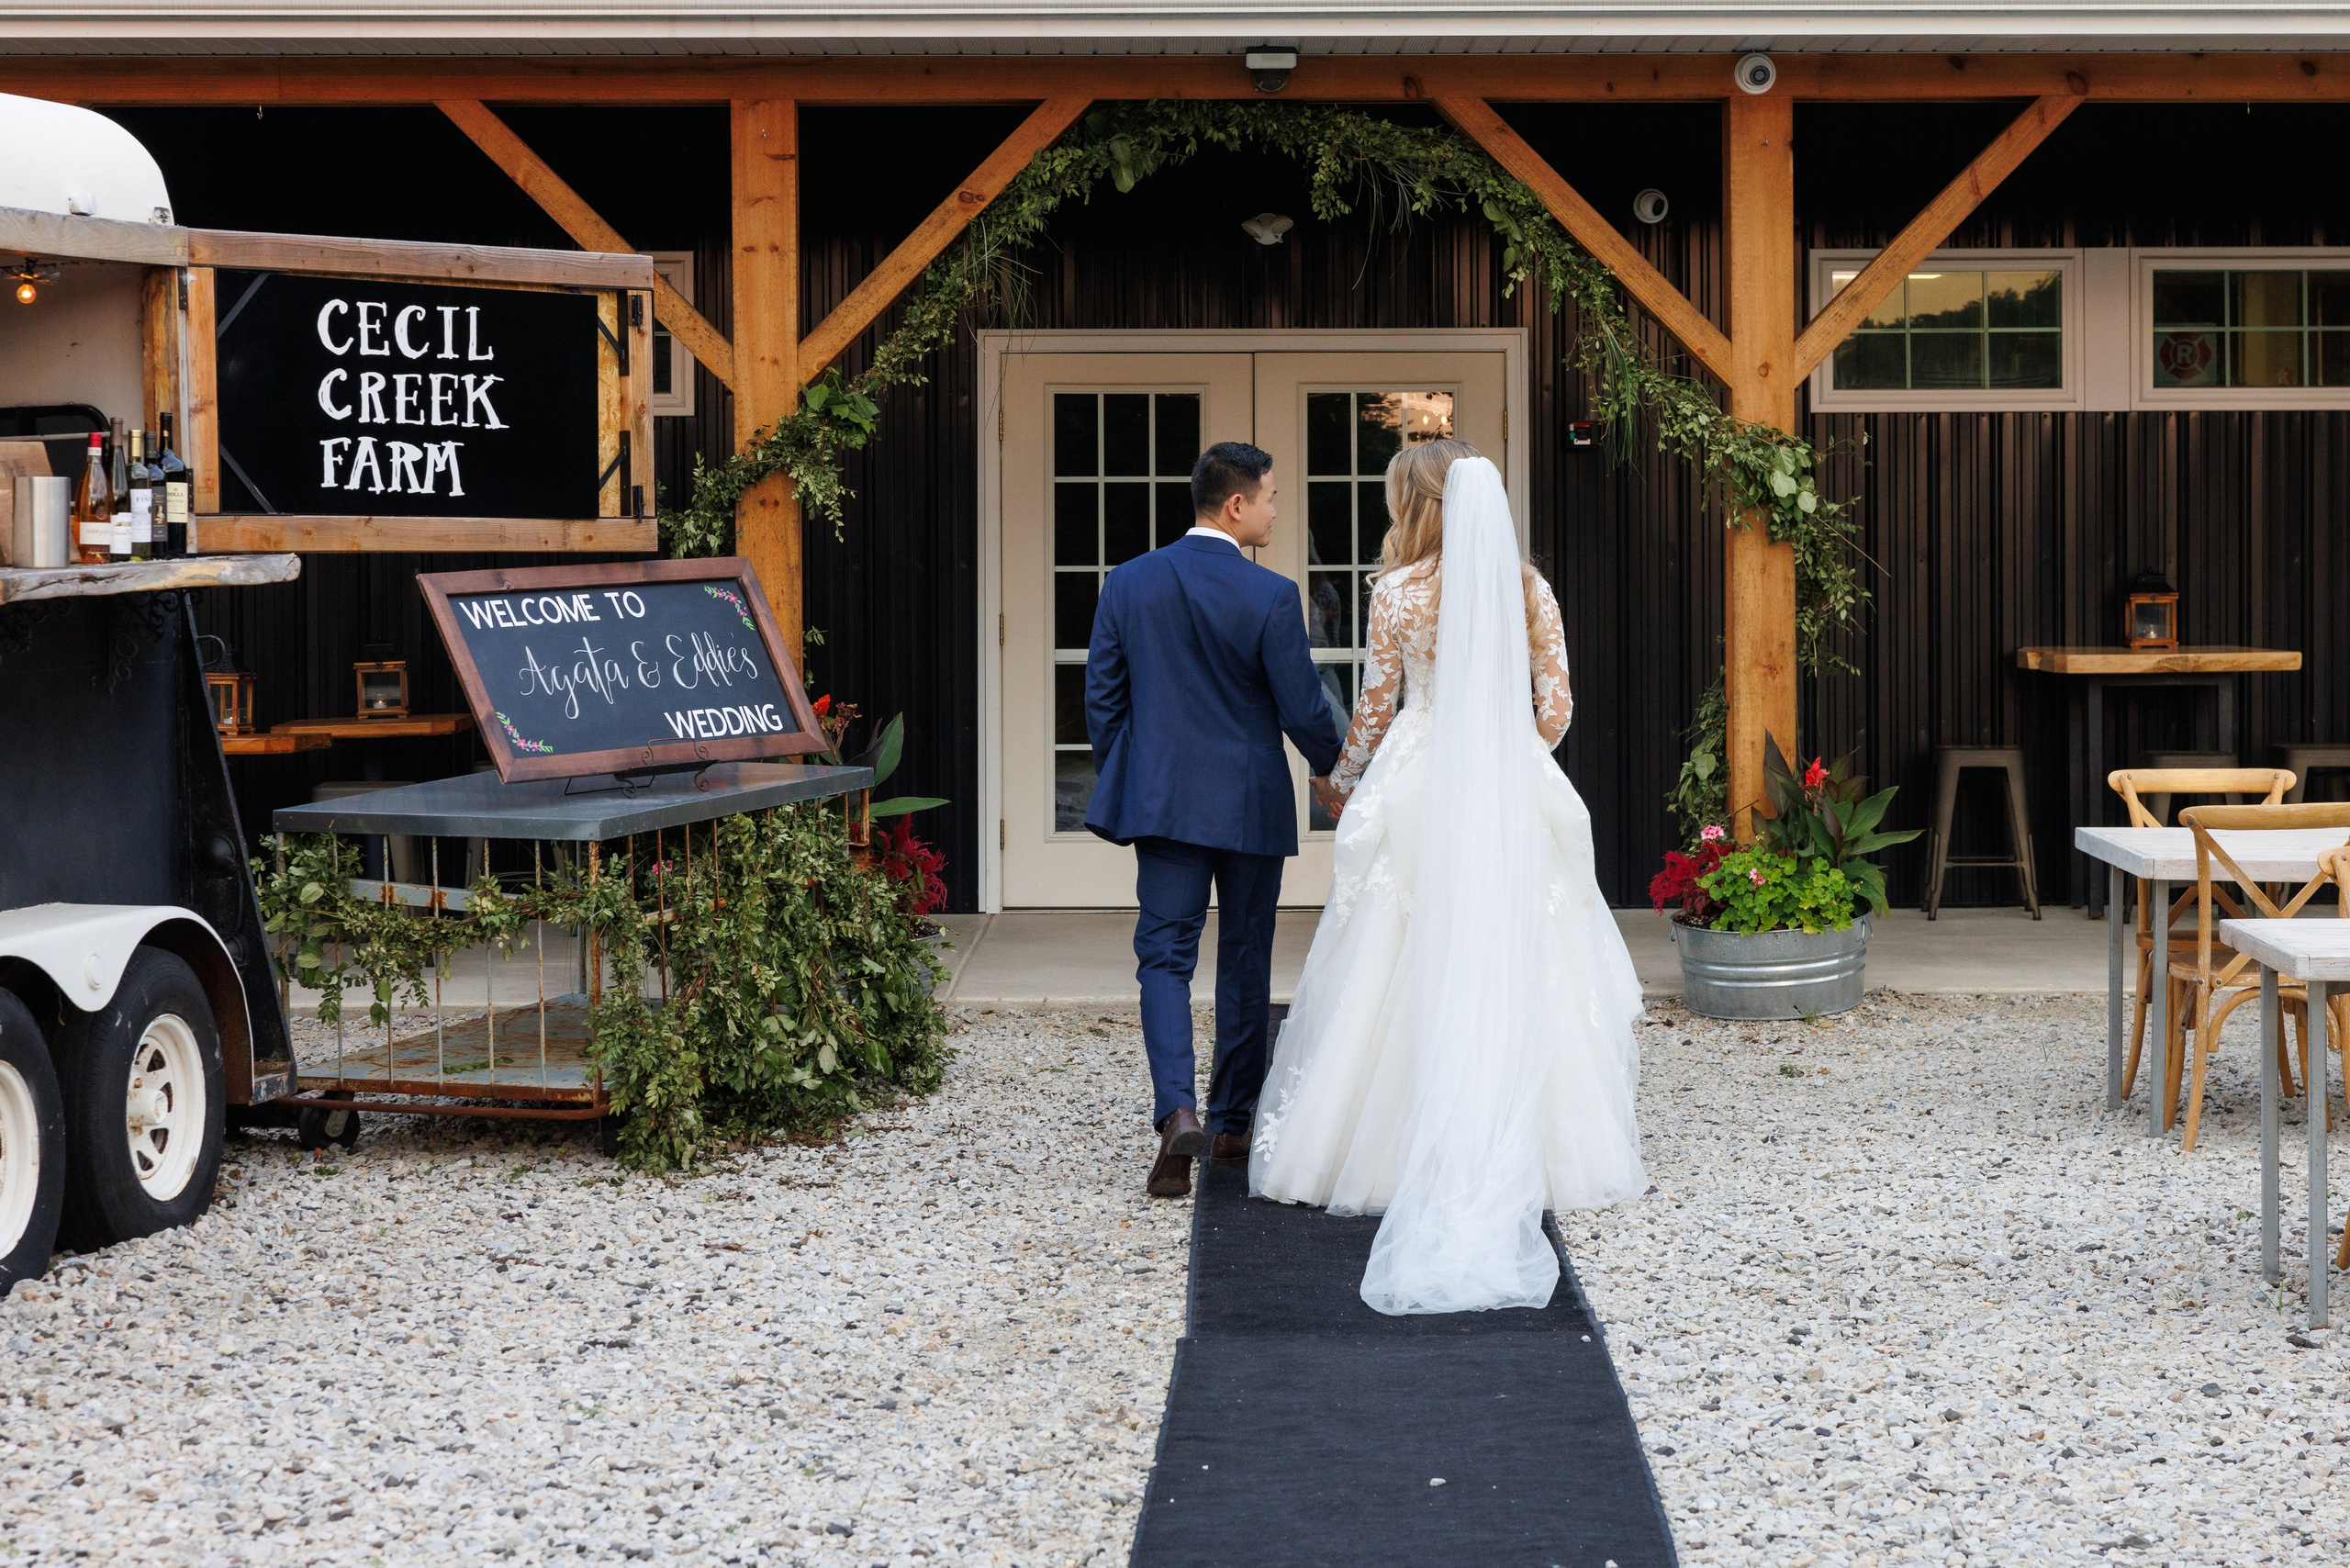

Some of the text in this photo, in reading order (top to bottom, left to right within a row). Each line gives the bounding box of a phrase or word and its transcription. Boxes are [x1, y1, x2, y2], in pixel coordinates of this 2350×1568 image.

[317, 298, 495, 361] CECIL
[2177, 344, 2193, 364] R
[318, 368, 510, 430] CREEK
[319, 436, 465, 497] FARM
[459, 590, 646, 630] WELCOME TO
[519, 631, 758, 720] Agata & Eddie's
[664, 703, 784, 739] WEDDING
